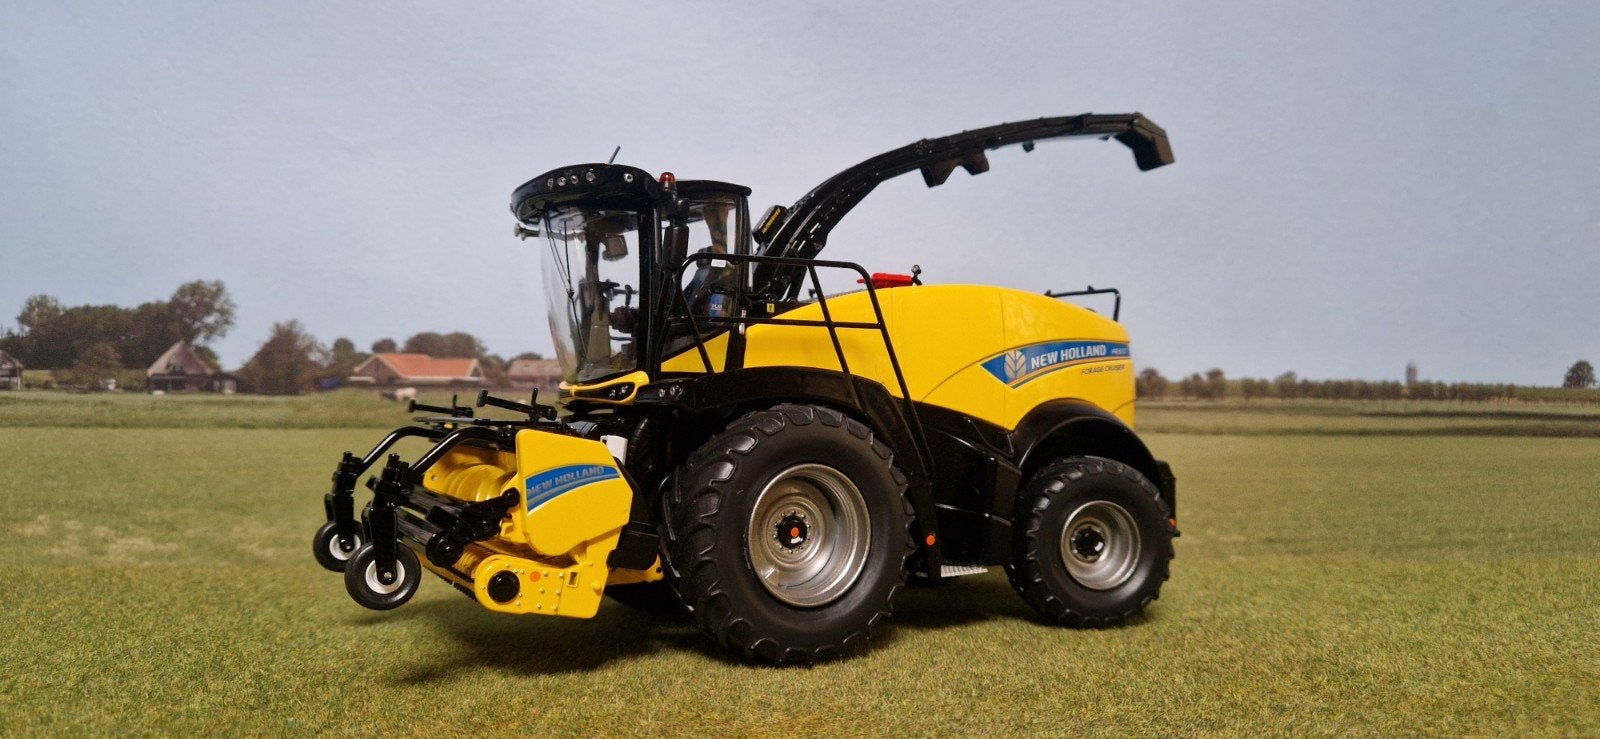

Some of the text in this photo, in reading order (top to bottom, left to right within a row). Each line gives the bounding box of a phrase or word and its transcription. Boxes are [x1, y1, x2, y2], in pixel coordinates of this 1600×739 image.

[1031, 351, 1057, 369] NEW
[1060, 345, 1107, 361] HOLLAND
[1081, 366, 1104, 375] FORAGE
[527, 467, 605, 496] NEW HOLLAND
